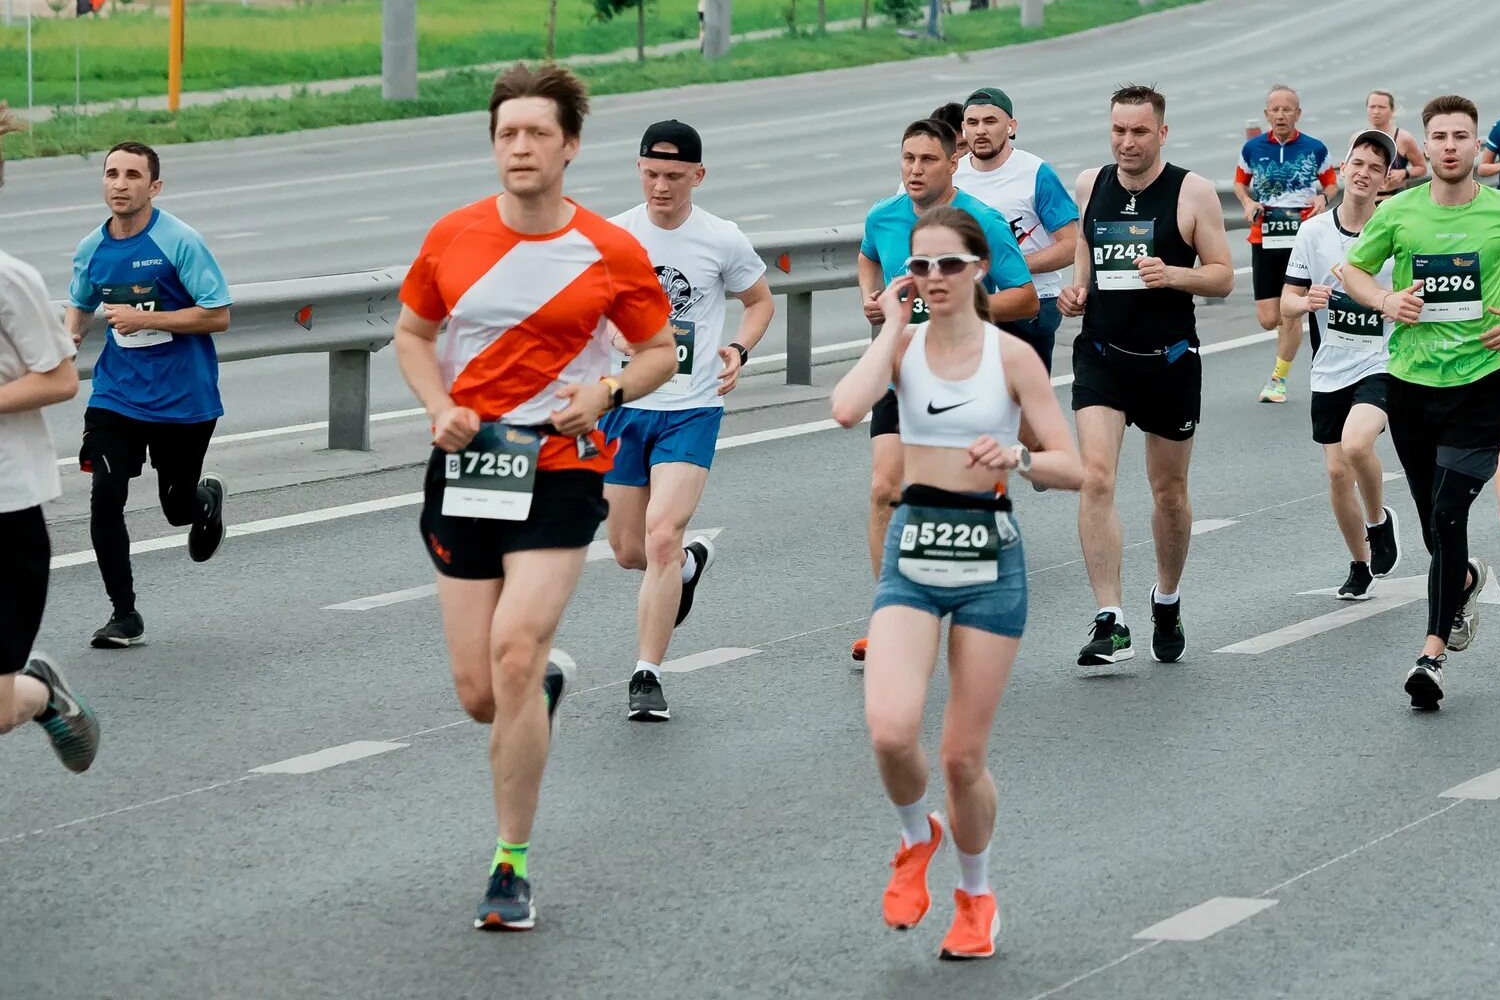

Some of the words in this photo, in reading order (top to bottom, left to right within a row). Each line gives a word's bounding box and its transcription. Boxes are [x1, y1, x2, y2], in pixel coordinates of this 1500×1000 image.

[1269, 220, 1299, 232] 7318
[1103, 243, 1148, 260] 7243
[141, 258, 162, 267] NEFAZ
[1425, 274, 1475, 293] 8296
[1337, 309, 1379, 327] 7814
[464, 451, 530, 479] 7250
[918, 521, 989, 548] 5220
